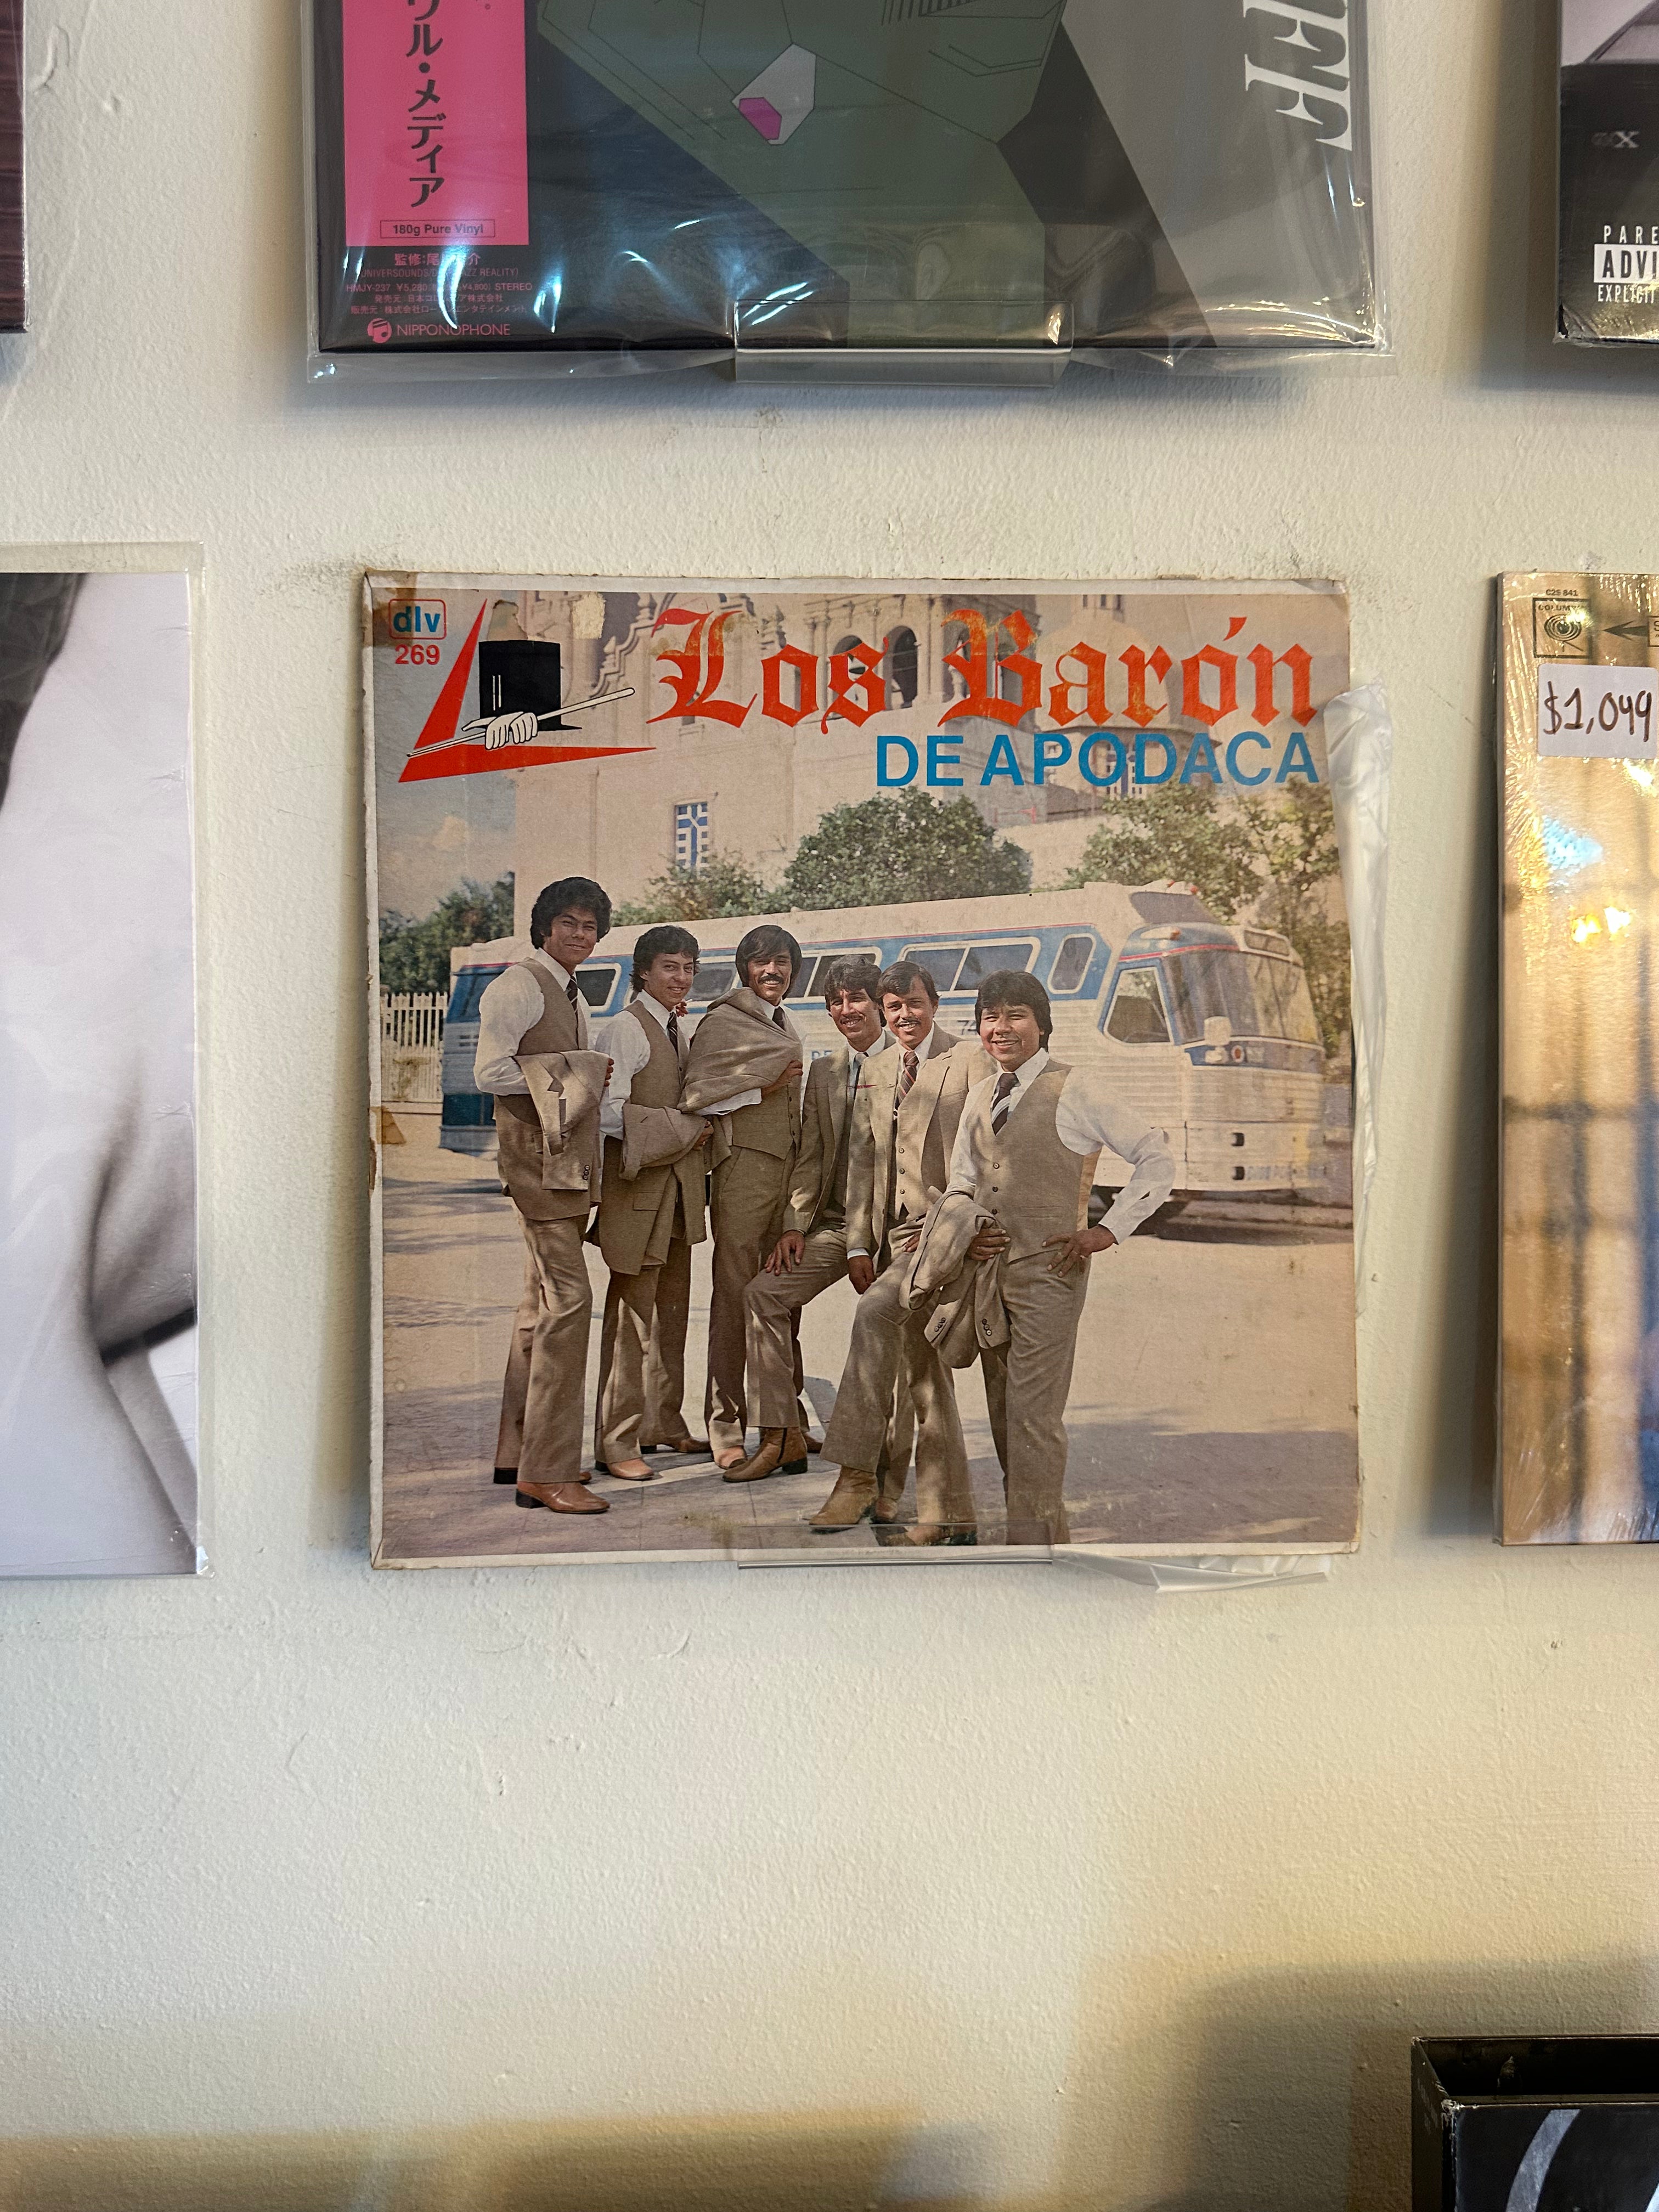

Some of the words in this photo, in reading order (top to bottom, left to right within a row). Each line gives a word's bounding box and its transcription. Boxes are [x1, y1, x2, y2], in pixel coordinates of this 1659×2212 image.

[393, 225, 420, 236] 180g
[424, 224, 451, 234] Pure
[455, 224, 483, 235] Vinyl
[1604, 225, 1659, 244] PARE
[394, 253, 481, 266] 監修:尾介
[1602, 250, 1657, 279] ADVI
[495, 283, 532, 291] STEREO
[397, 324, 511, 336] NIPPONOPHONE
[393, 606, 441, 633] dlv
[394, 644, 441, 665] 269
[646, 608, 889, 735] Los
[937, 608, 1318, 729] Barón
[1543, 681, 1652, 743] $1,049
[877, 735, 964, 787] DE
[979, 731, 1319, 787] APODACA
